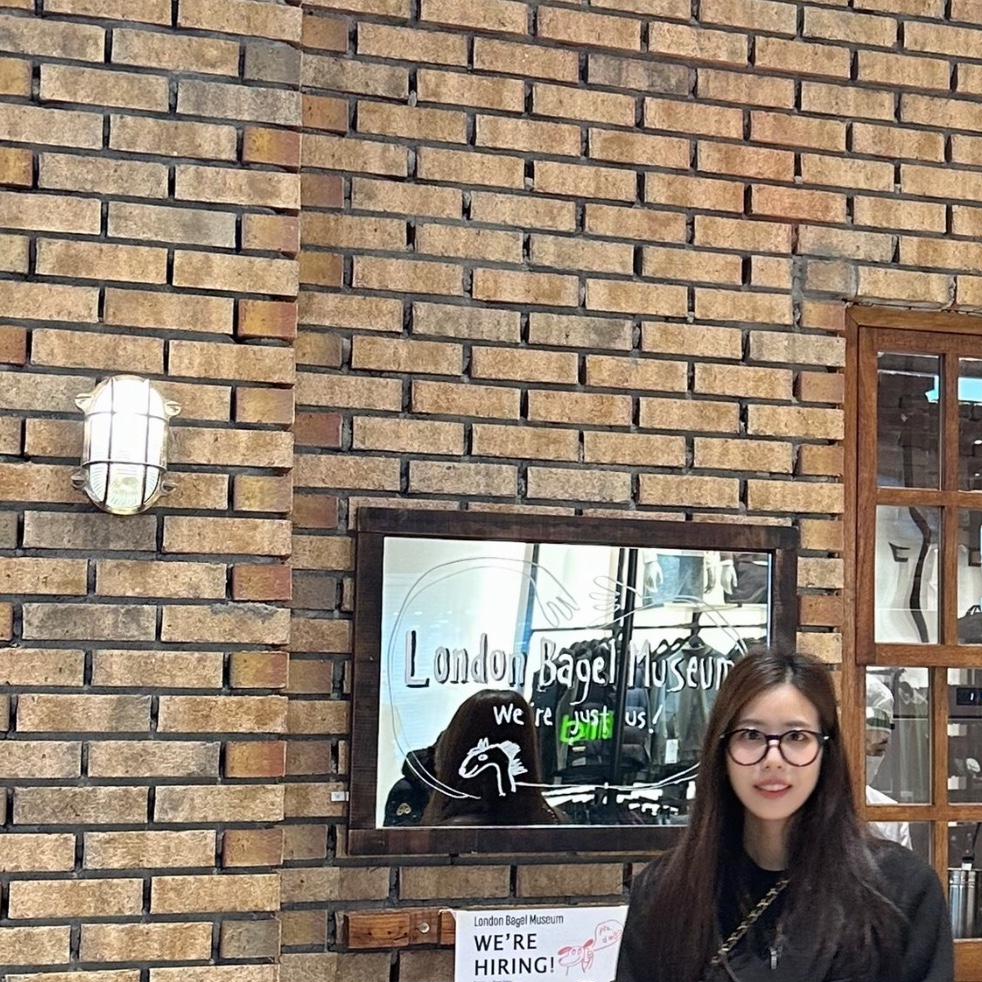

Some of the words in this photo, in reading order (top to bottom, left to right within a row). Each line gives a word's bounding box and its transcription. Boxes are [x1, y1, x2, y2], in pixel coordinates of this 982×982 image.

[405, 630, 527, 688] London
[537, 636, 616, 706] Bagel
[570, 705, 610, 736] just
[624, 704, 663, 734] us!
[474, 915, 504, 927] London
[505, 914, 528, 928] Bagel
[529, 914, 564, 925] Museum
[473, 933, 537, 952] WE'RE
[474, 956, 554, 976] HIRING!
